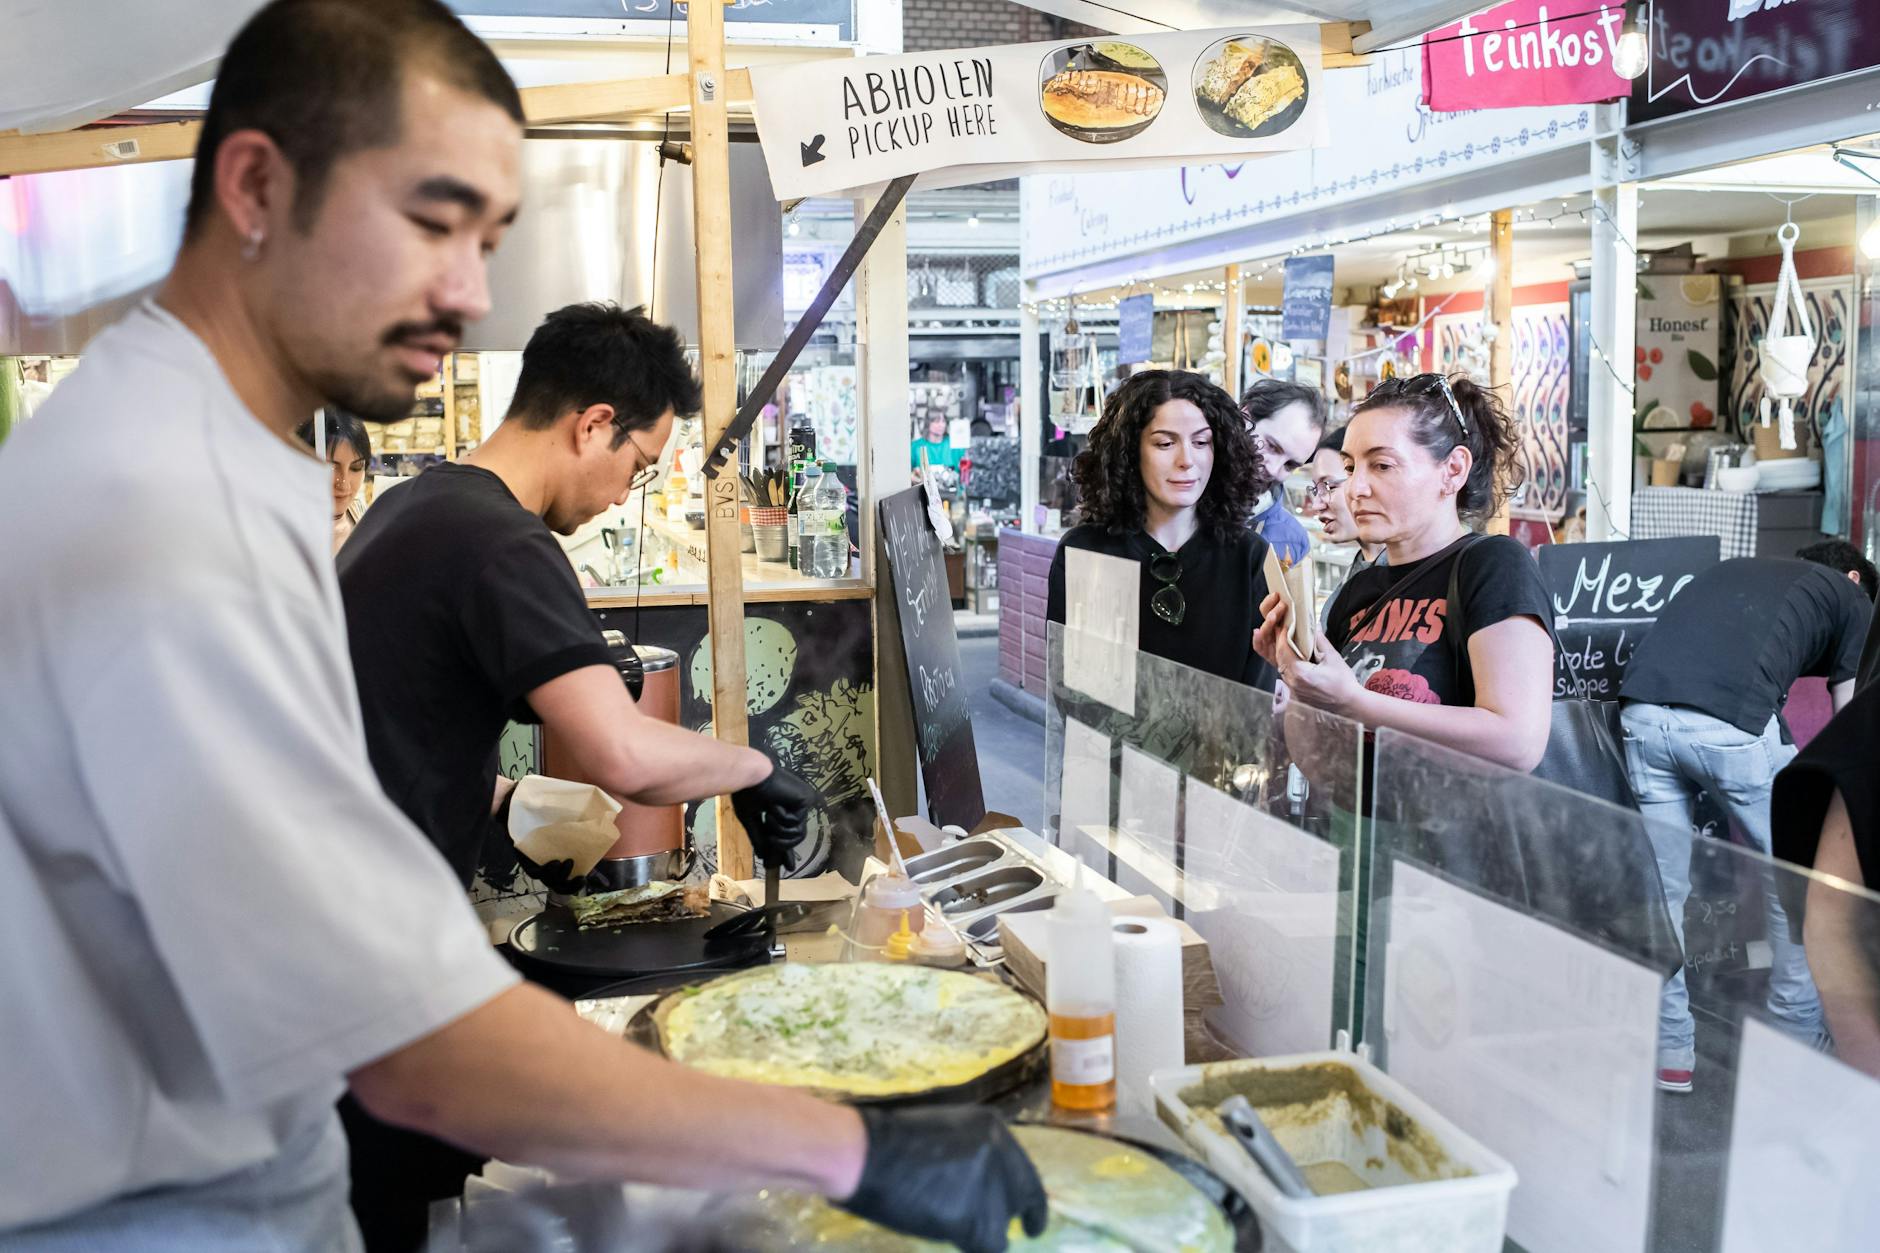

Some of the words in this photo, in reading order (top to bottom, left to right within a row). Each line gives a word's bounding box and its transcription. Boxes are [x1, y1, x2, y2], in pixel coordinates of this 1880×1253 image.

[843, 58, 993, 120] ABHOLEN
[848, 112, 933, 159] PICKUP
[947, 103, 997, 138] HERE
[1649, 317, 1709, 332] Honest
[715, 480, 735, 519] BVS
[1560, 635, 1605, 671] rote
